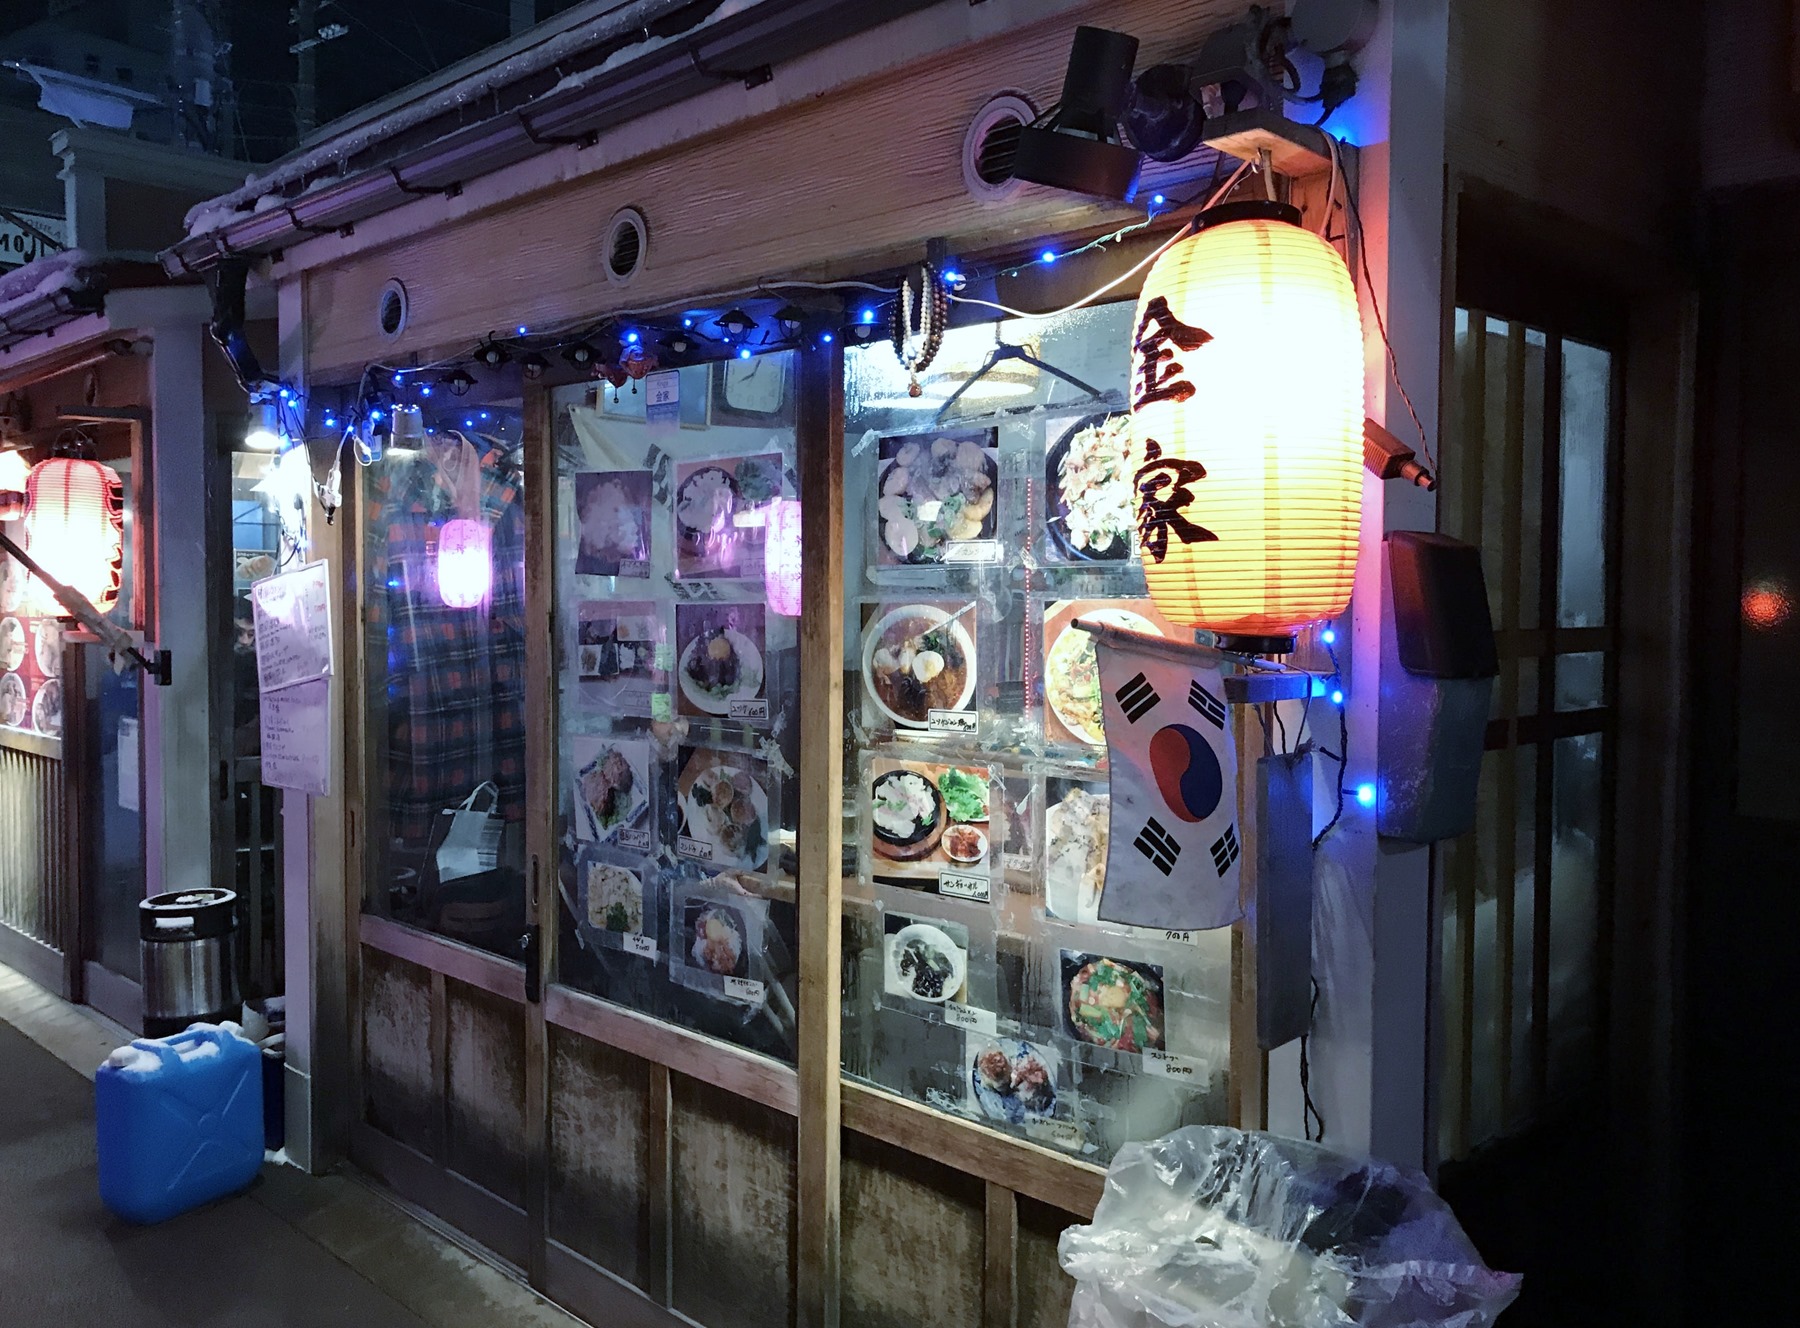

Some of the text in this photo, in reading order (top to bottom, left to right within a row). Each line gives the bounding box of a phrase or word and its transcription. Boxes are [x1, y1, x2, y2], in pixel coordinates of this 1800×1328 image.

[1131, 295, 1220, 565] 金家
[1166, 931, 1190, 943] 700円
[955, 1013, 978, 1024] 800円
[1166, 1063, 1193, 1075] 800円
